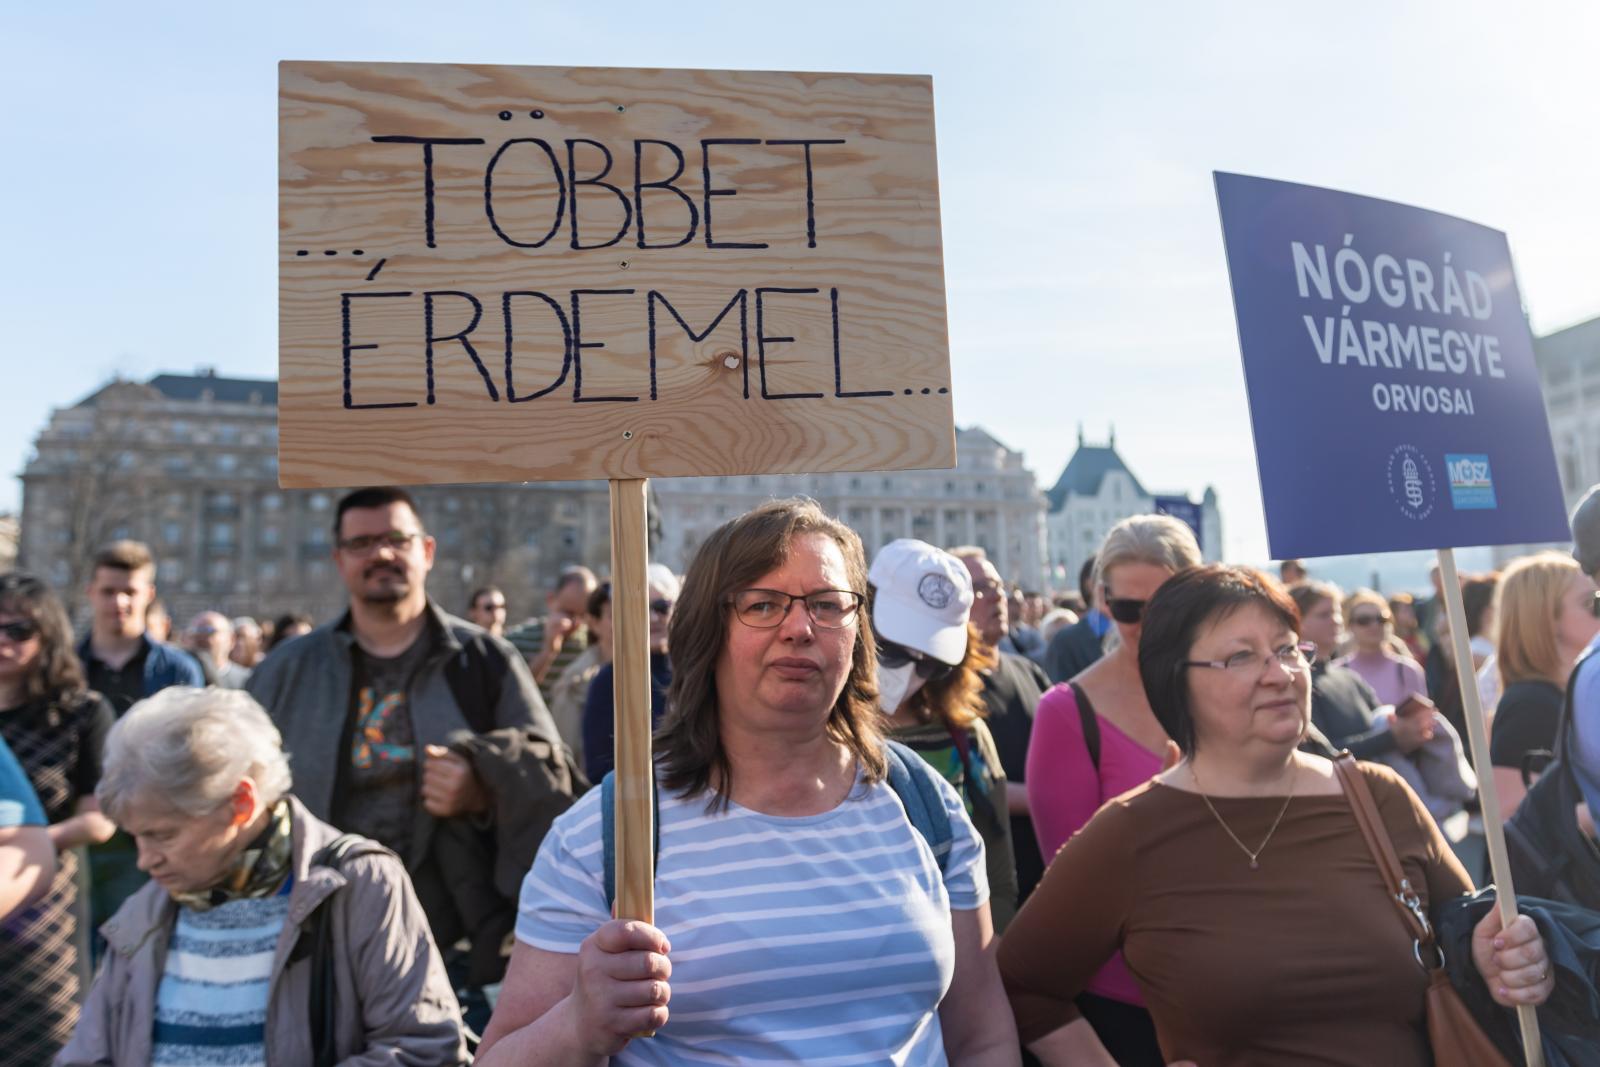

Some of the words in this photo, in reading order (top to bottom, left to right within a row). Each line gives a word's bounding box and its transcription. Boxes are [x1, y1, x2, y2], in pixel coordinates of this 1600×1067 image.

[1290, 232, 1493, 321] NÓGRÁD
[1302, 304, 1506, 379] VÁRMEGYE
[1371, 382, 1475, 416] ORVOSAI
